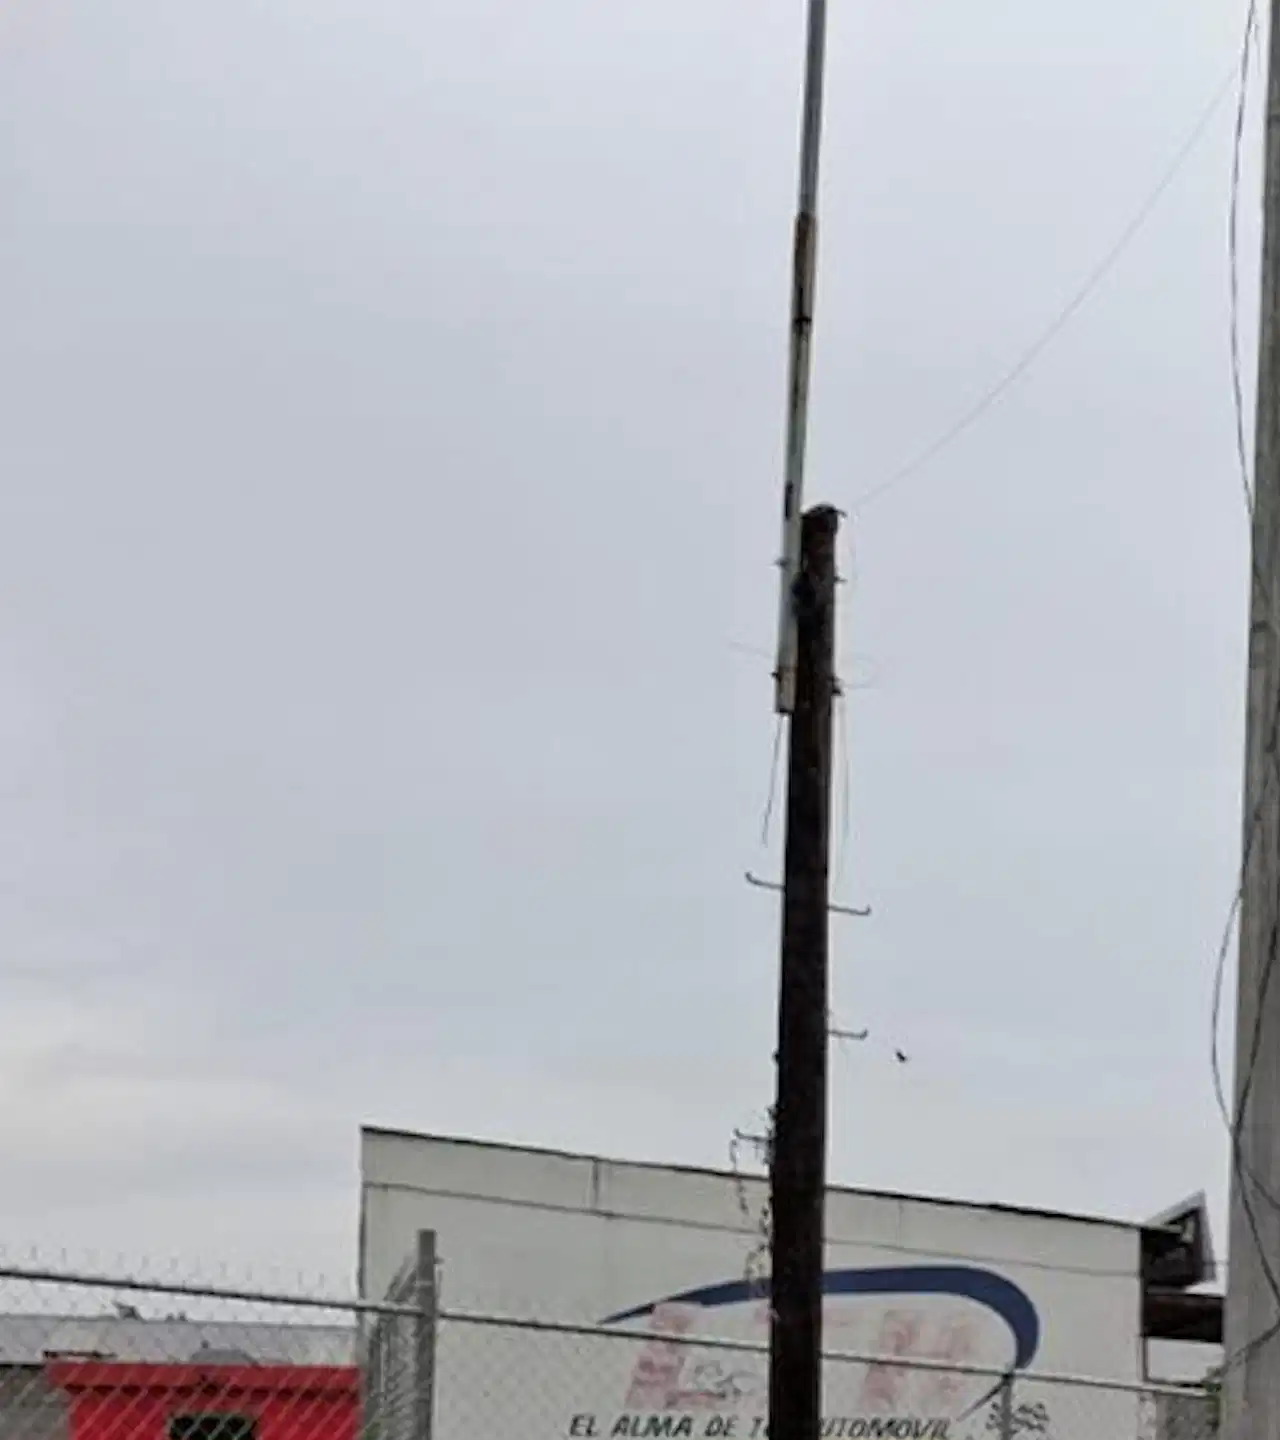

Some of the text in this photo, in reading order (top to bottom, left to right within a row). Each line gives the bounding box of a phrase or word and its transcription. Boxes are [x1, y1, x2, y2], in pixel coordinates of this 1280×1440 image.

[569, 1413, 602, 1438] EL
[610, 1413, 694, 1438] ALMA
[704, 1413, 739, 1438] DE
